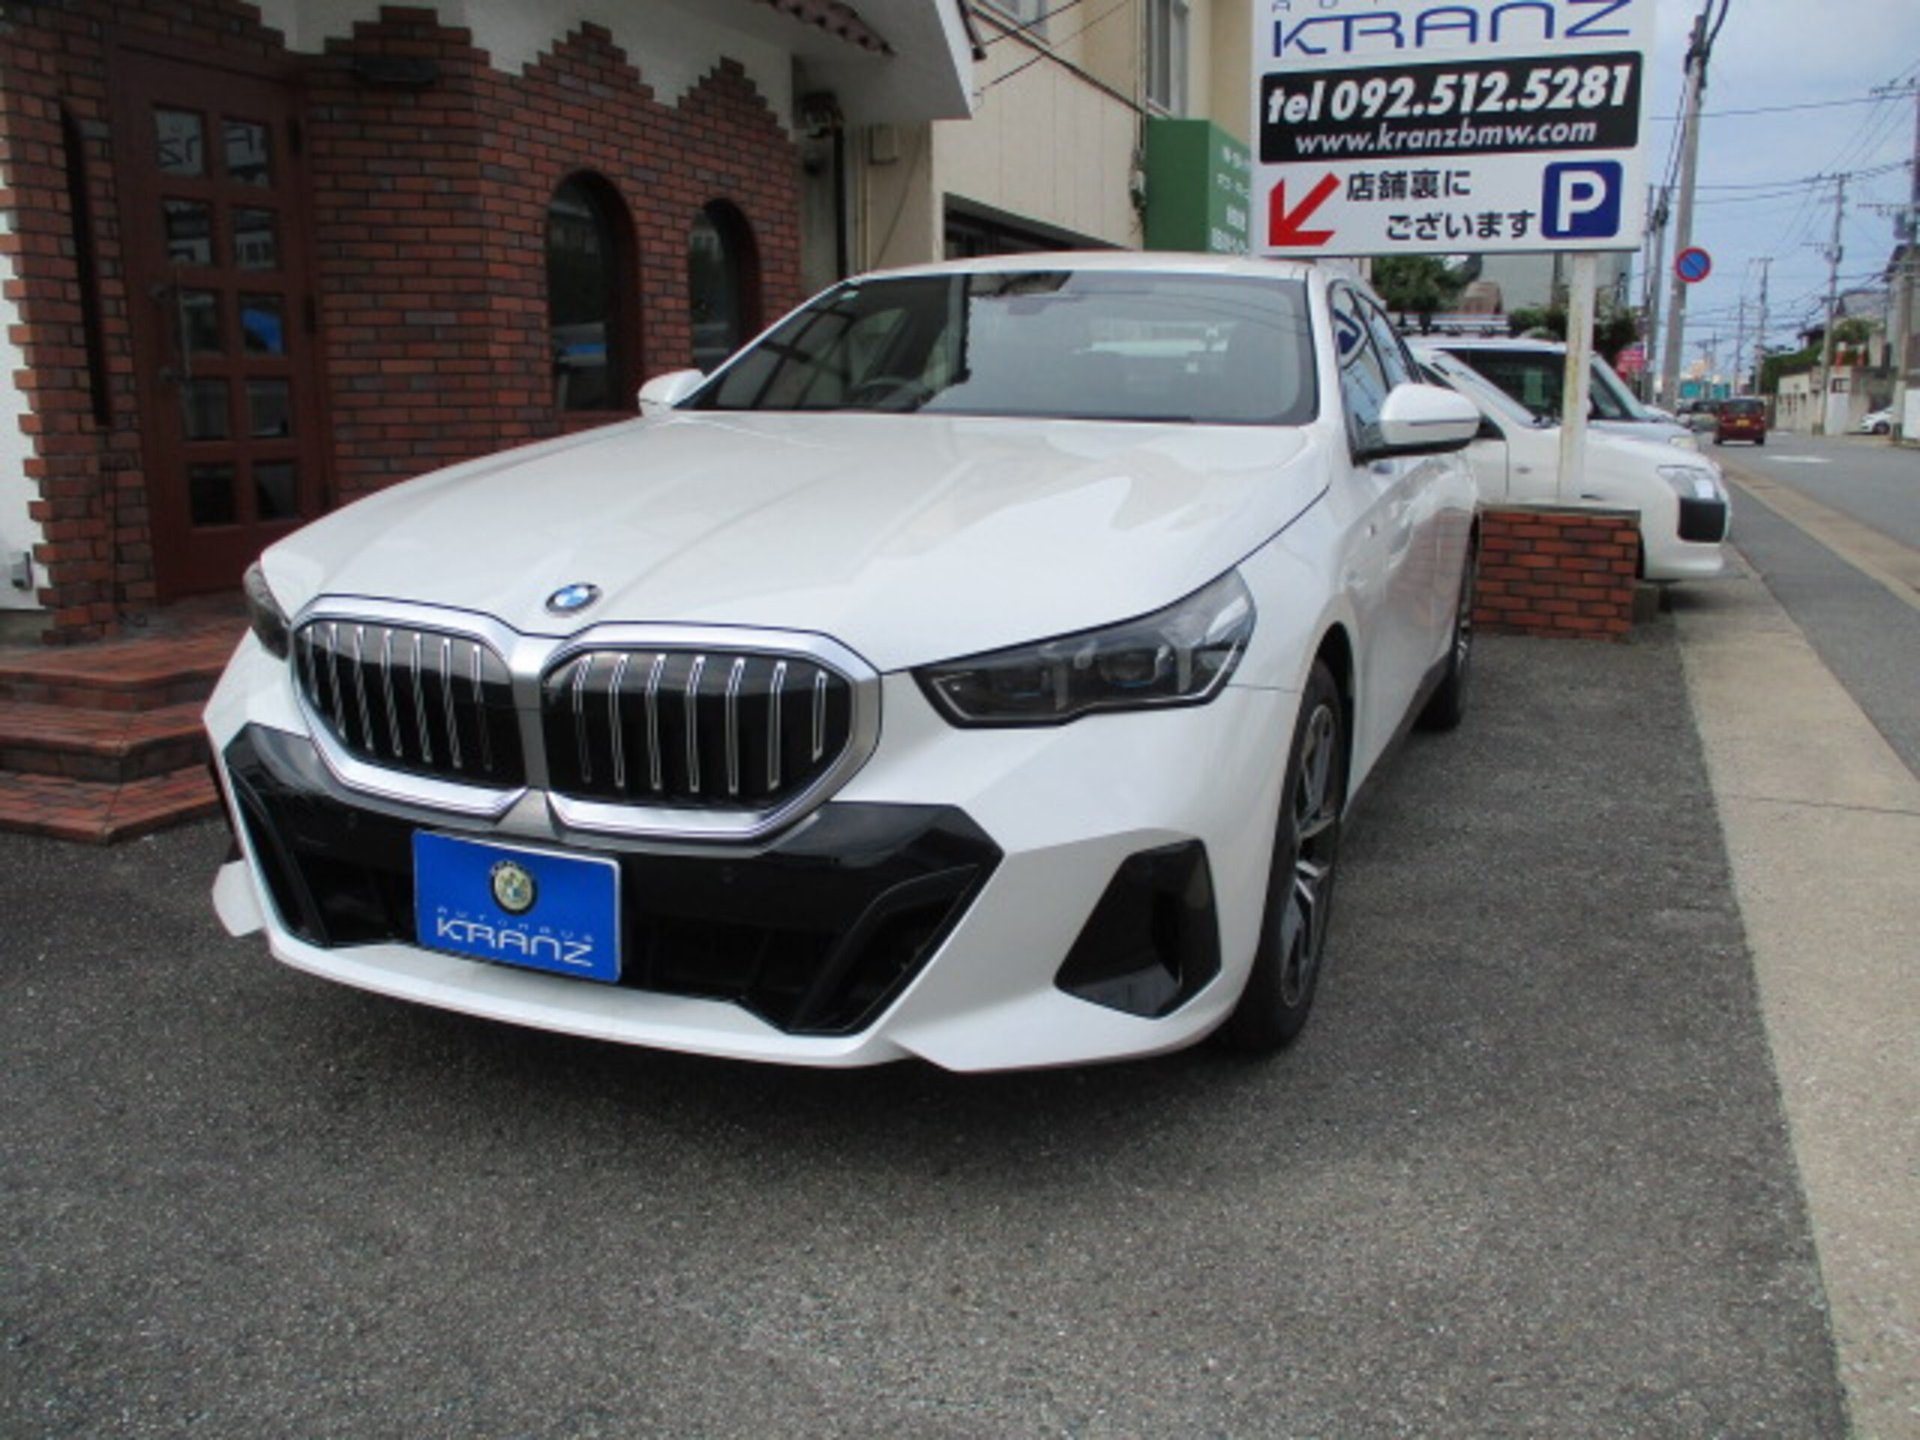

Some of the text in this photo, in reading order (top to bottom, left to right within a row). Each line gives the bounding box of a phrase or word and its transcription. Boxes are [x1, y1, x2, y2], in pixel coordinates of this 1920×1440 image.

[1274, 0, 1633, 57] KRANZ
[1267, 65, 1632, 123] tel 092.512.5281
[1295, 119, 1597, 154] www.kranzbmw.com
[1346, 169, 1472, 201] 店舗裏に
[1556, 170, 1607, 232] P
[1386, 210, 1536, 241] ございます
[437, 917, 593, 967] KRANZ
